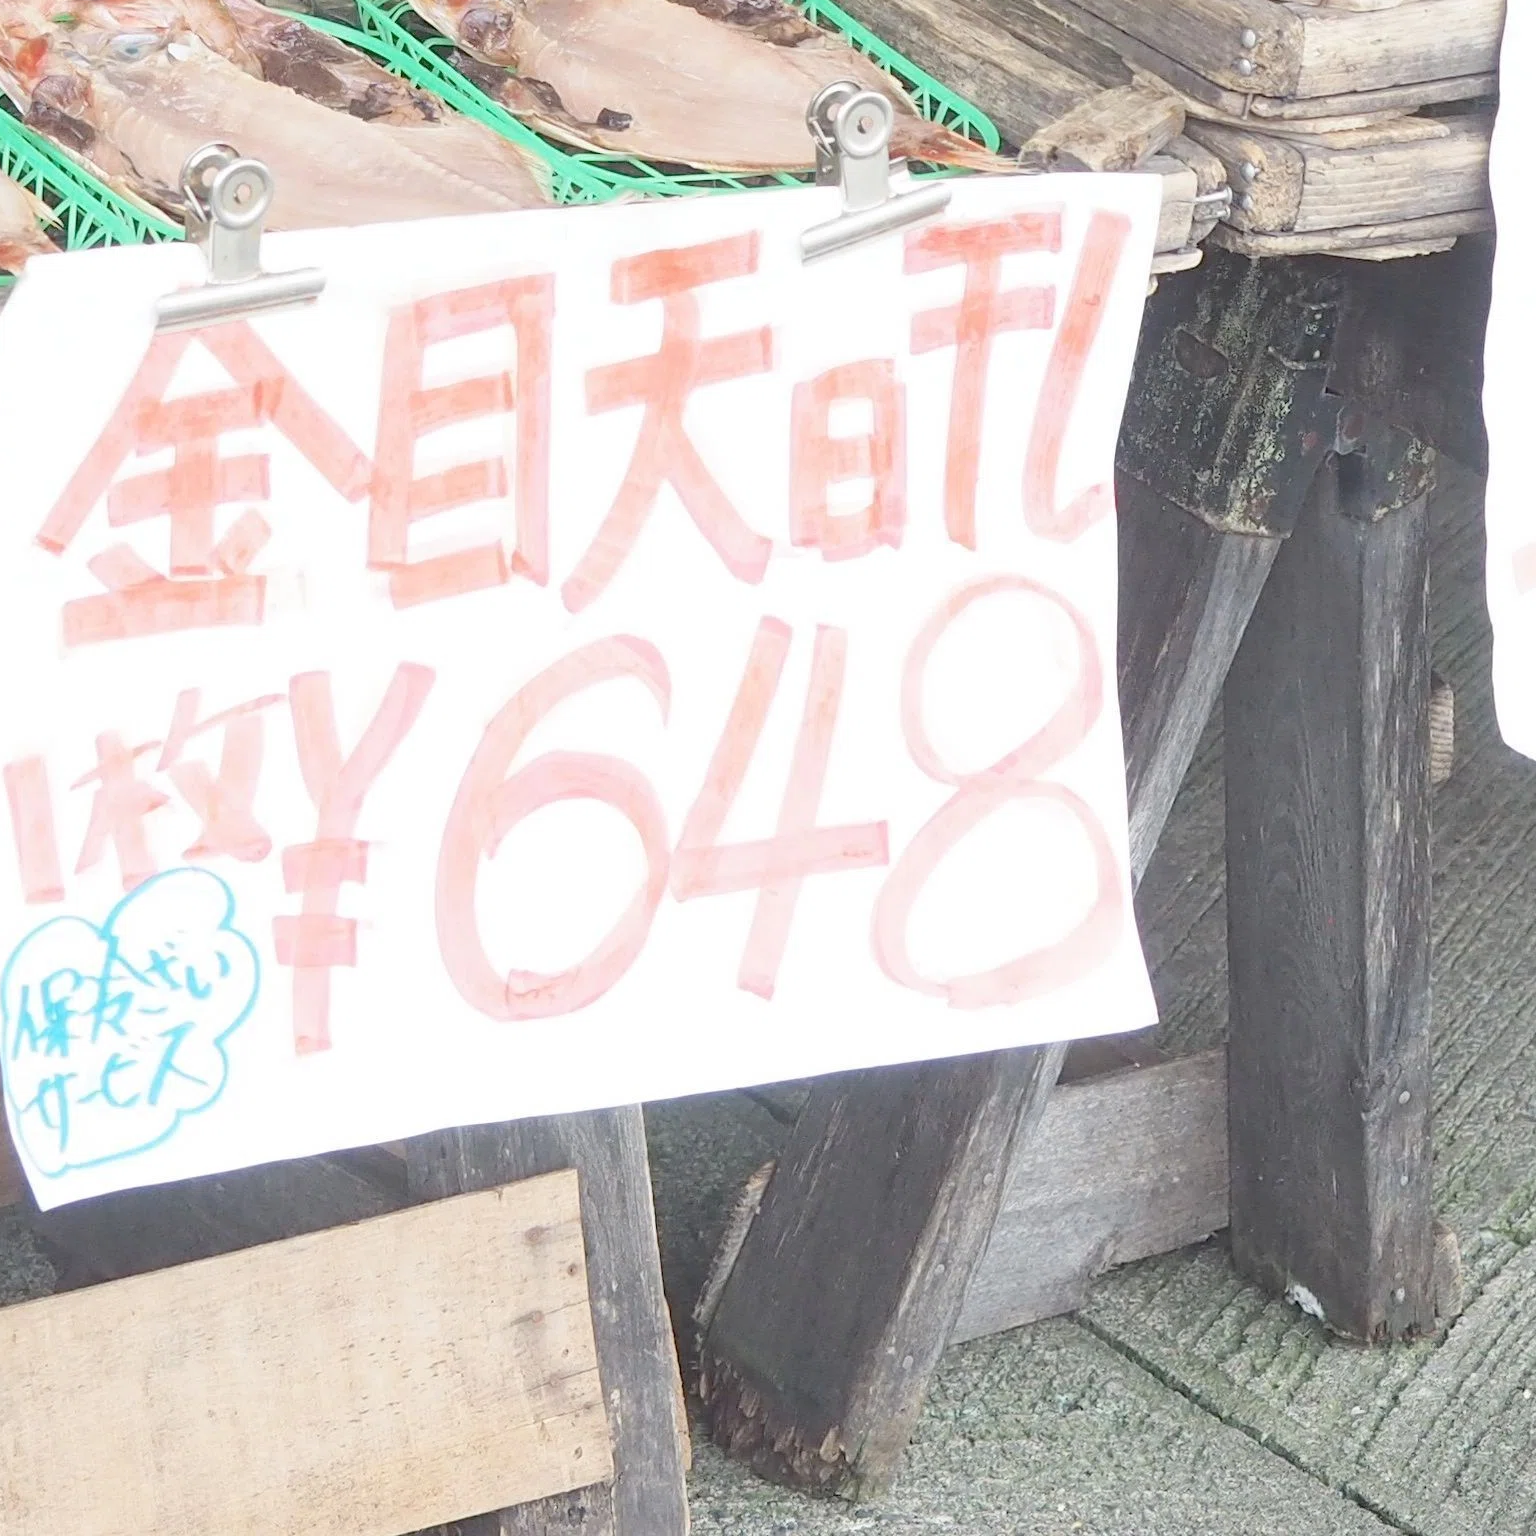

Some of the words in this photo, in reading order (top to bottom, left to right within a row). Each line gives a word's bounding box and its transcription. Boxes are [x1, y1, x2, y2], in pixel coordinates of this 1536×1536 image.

[33, 209, 1134, 648] 金目天日干し
[20, 1020, 210, 1154] サービス
